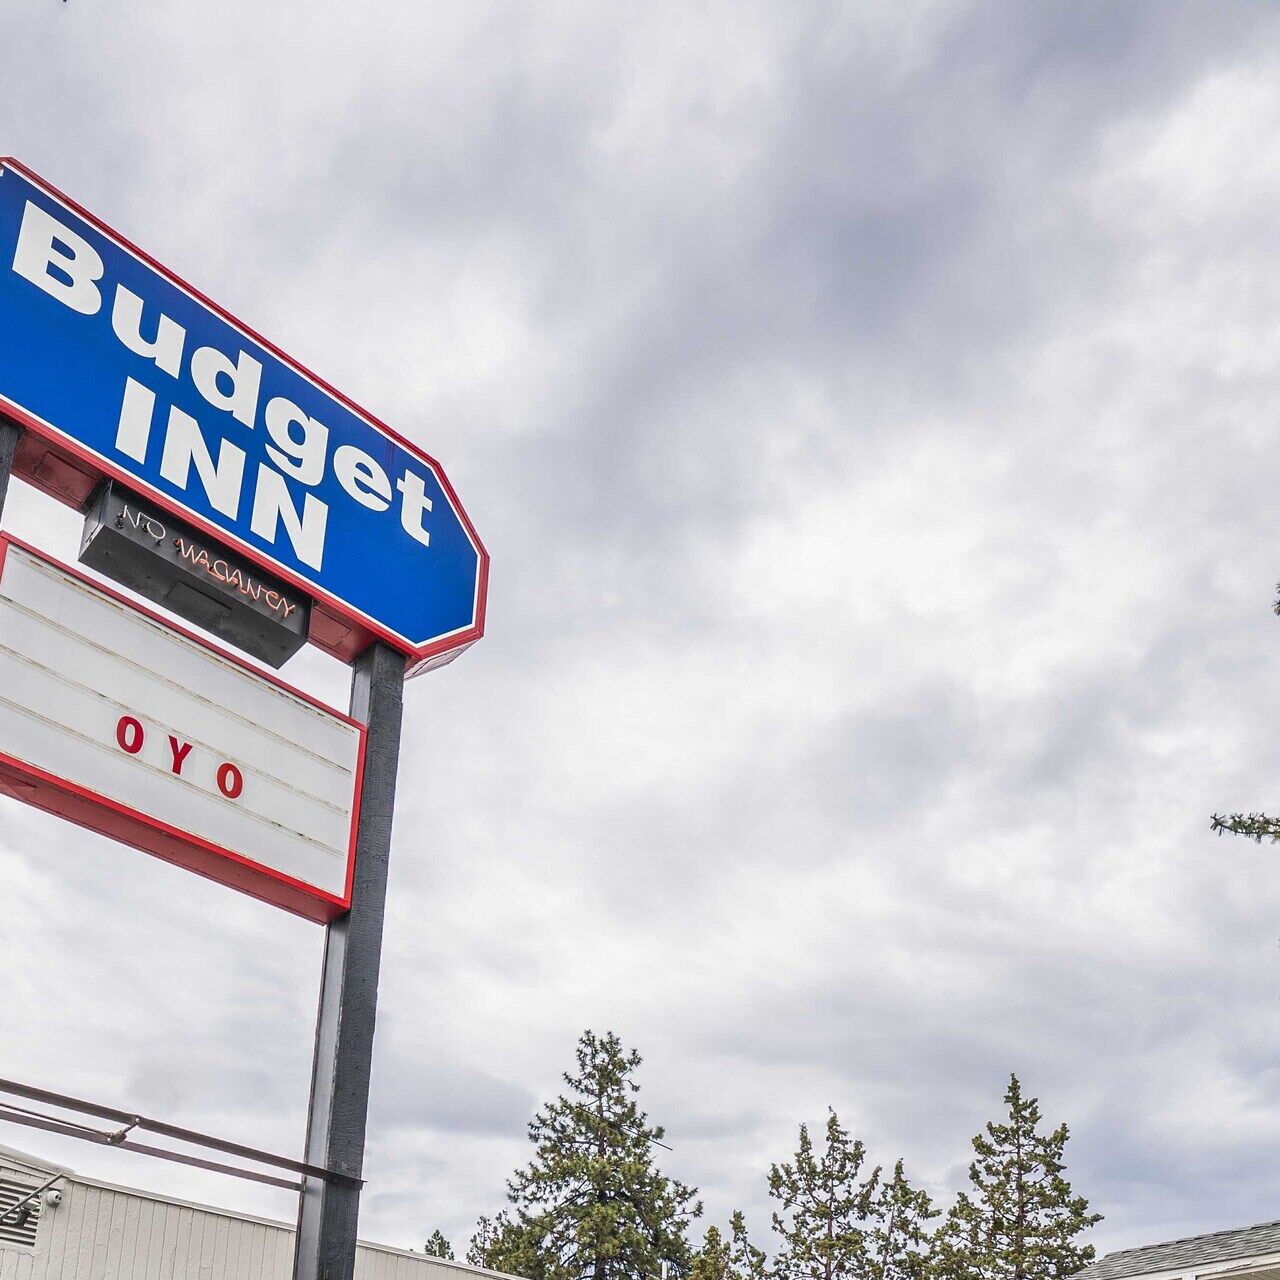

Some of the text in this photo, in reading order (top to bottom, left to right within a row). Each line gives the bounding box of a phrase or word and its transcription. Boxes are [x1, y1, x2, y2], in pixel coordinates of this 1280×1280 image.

[11, 198, 435, 548] Budget
[114, 375, 329, 573] INN
[122, 504, 296, 619] NO VACANCY
